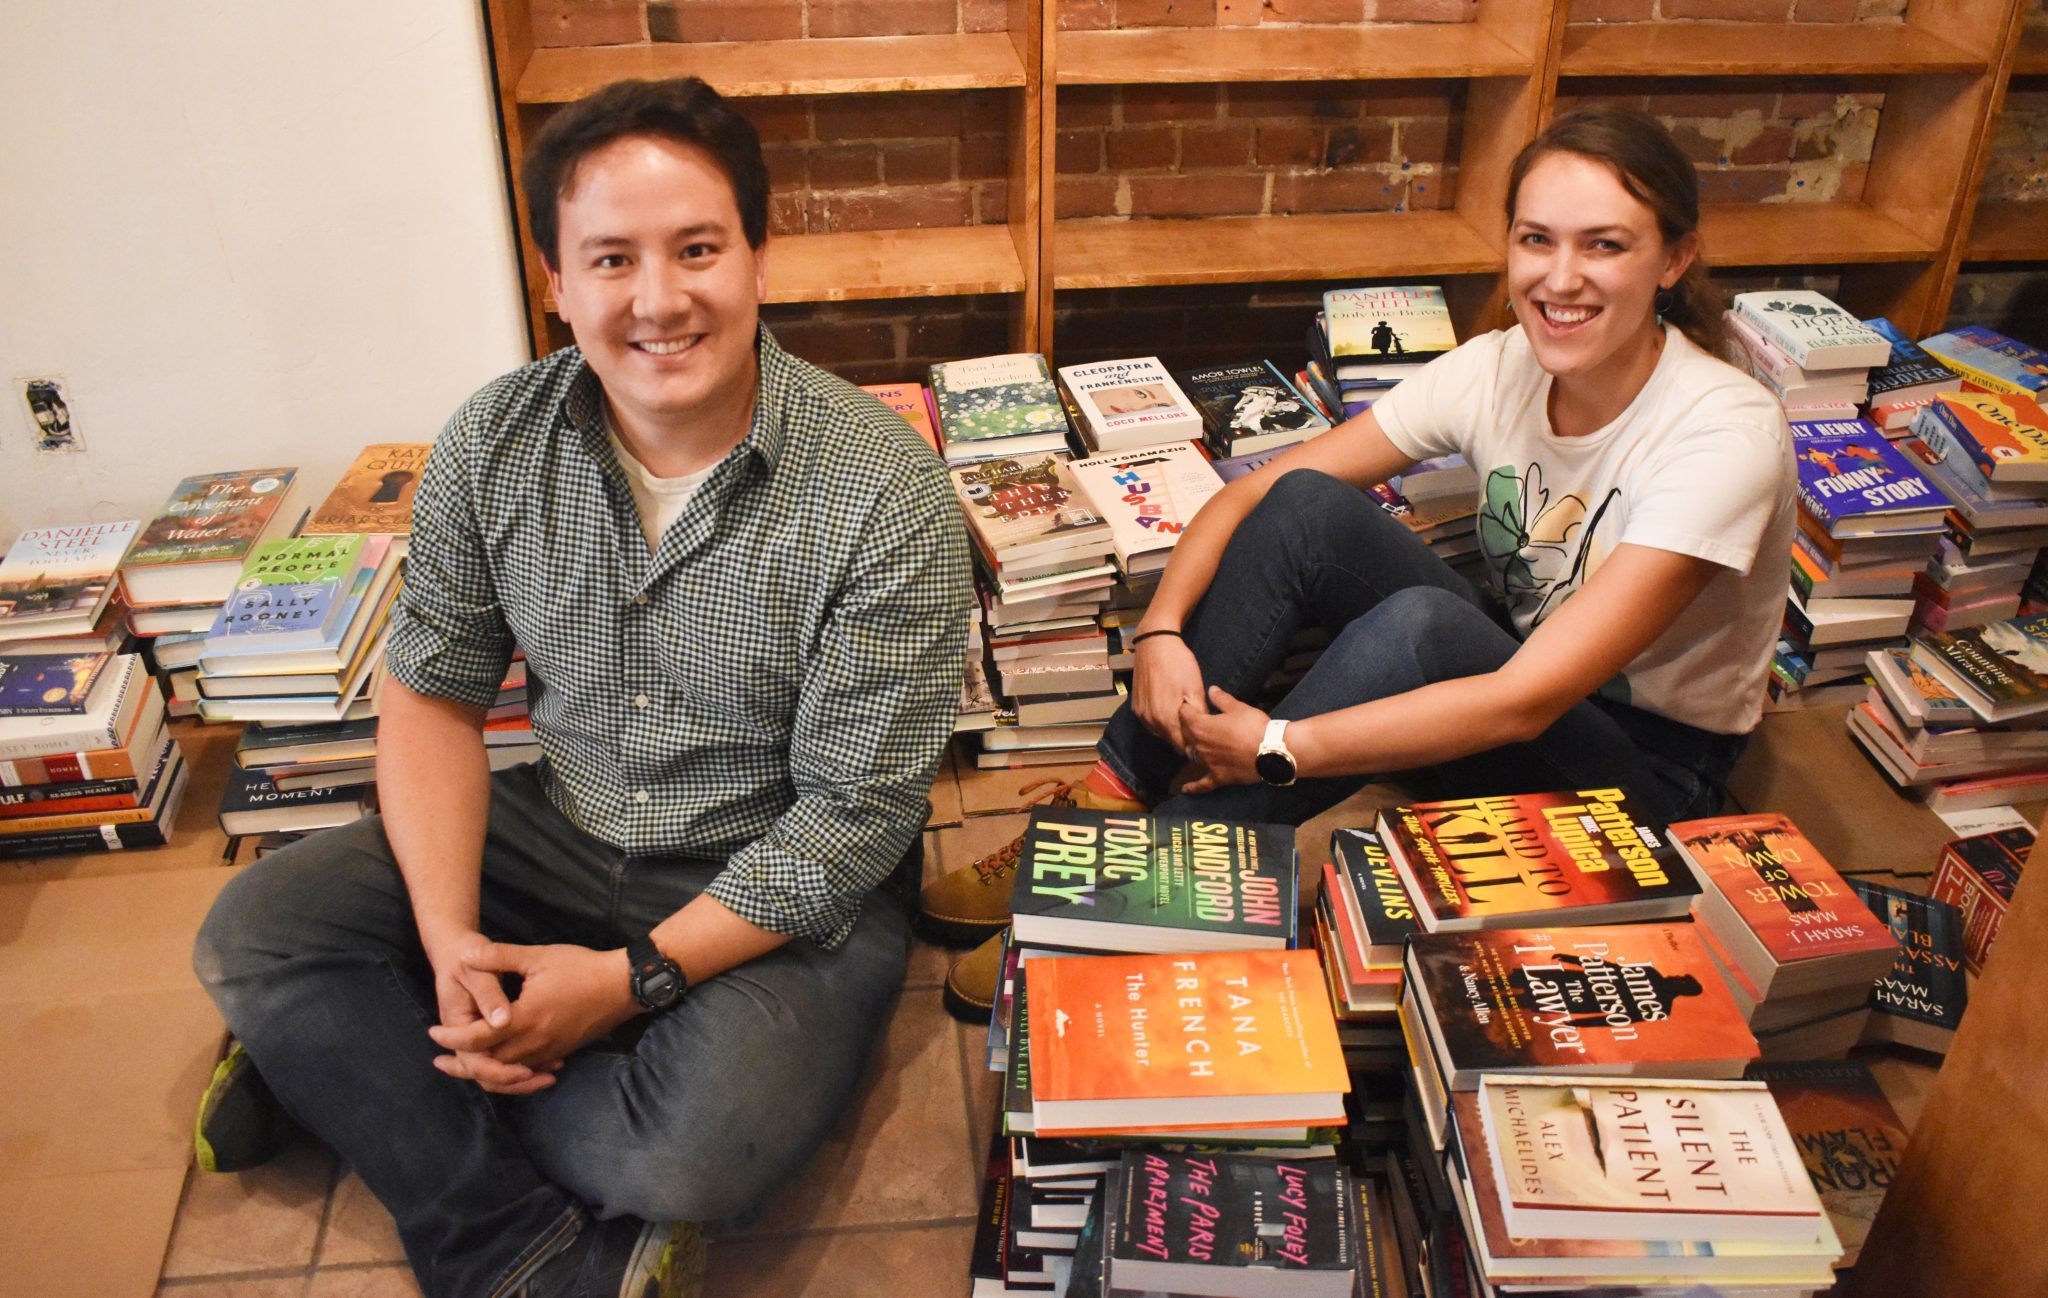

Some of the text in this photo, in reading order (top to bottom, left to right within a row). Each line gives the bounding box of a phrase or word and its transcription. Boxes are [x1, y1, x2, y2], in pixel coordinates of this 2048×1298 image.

[1331, 291, 1433, 302] DANIELLE
[1355, 300, 1411, 309] STEEL
[1333, 309, 1441, 319] Only the Brave
[1843, 337, 1883, 346] SILVER
[1073, 362, 1154, 378] CLEOPATRA
[1105, 371, 1130, 380] and
[1192, 372, 1224, 382] AMOR
[1225, 366, 1265, 376] TOWLES
[1872, 366, 1950, 391] HOOVER
[1079, 374, 1164, 391] FRANKENSTEIN
[1973, 373, 2013, 397] JIMENEZ
[1106, 411, 1189, 428] COCO MELLORS
[1976, 403, 2018, 427] One
[1813, 422, 1867, 436] HENRY
[388, 448, 429, 458] KAT
[1079, 446, 1187, 469] HOLLY GRAMAZIO
[208, 483, 246, 495] The
[989, 483, 1050, 501] THIS
[1813, 467, 1886, 498] FUNNY
[1861, 477, 1931, 507] STORY
[168, 496, 265, 513] Covenant
[983, 491, 1071, 514] OTHER
[1000, 502, 1069, 523] EDEN
[1112, 471, 1186, 534] HUSBAN
[194, 511, 222, 525] of
[21, 522, 134, 541] DANIELLE
[38, 536, 104, 551] STEEL
[166, 527, 228, 541] Water
[256, 561, 339, 573] PEOPLE
[259, 548, 349, 562] NORMAL
[244, 597, 314, 610] SALLY
[223, 608, 319, 624] ROONEY
[1940, 644, 1996, 687] Miracles
[1955, 639, 2015, 687] Counting
[49, 765, 80, 774] HOMER
[49, 786, 118, 799] SEAMUS HEANEY
[249, 788, 338, 803] MOMENT
[1578, 815, 1601, 833] MIKE
[1172, 833, 1183, 852] LUCAS
[1485, 798, 1572, 896] HARD TO
[1541, 805, 1611, 873] Lupica
[1576, 788, 1670, 887] Patterson
[1635, 826, 1662, 848] JAMES
[1103, 817, 1148, 883] TOXIC
[1173, 854, 1183, 867] AND
[1402, 815, 1424, 835] JANE
[1414, 838, 1441, 865] SMITH
[1430, 865, 1462, 905] THRILLER
[1723, 847, 1803, 869] DAWN
[1031, 821, 1098, 907] PREY
[1158, 847, 1171, 904] DAVENPORT NOVEL
[1191, 821, 1236, 924] SANDFORD
[1764, 868, 1789, 882] OF
[1174, 868, 1185, 887] LETTY
[1363, 845, 1415, 920] DEVLINS
[1239, 869, 1283, 926] JOHN
[1744, 880, 1840, 904] TOWER
[1788, 910, 1839, 925] MAAS
[1804, 925, 1865, 942] SARAH
[1462, 972, 1482, 1001] Nancy
[1472, 1001, 1491, 1024] Allen
[1565, 980, 1584, 1003] The
[1572, 941, 1640, 1042] Patterson
[1615, 955, 1669, 1023] James
[1520, 961, 1588, 1055] Lawyer
[1876, 989, 1944, 1017] SARAH
[1096, 1011, 1105, 1037] NOVEL
[1125, 973, 1151, 1068] The Hunter
[1172, 961, 1215, 1077] FRENCH
[1224, 976, 1262, 1056] TANA
[1495, 993, 1510, 1020] MURDER
[1505, 1021, 1522, 1049] SUSPECT
[1509, 997, 1520, 1012] BEST
[1515, 1013, 1533, 1040] LAWYER
[1018, 1038, 1029, 1059] ONE
[1016, 1063, 1028, 1090] LEFT
[1504, 1088, 1545, 1196] MICHAELIDES
[1538, 1120, 1565, 1161] ALEX
[1608, 1089, 1672, 1202] PATIENT
[1666, 1097, 1728, 1197] SILENT
[1728, 1130, 1759, 1165] THE
[1136, 1154, 1170, 1260] APARTMENT
[1180, 1158, 1220, 1261] THE PARIS
[1254, 1200, 1262, 1227] NOVEL
[1276, 1164, 1309, 1265] LUCY FOLEY
